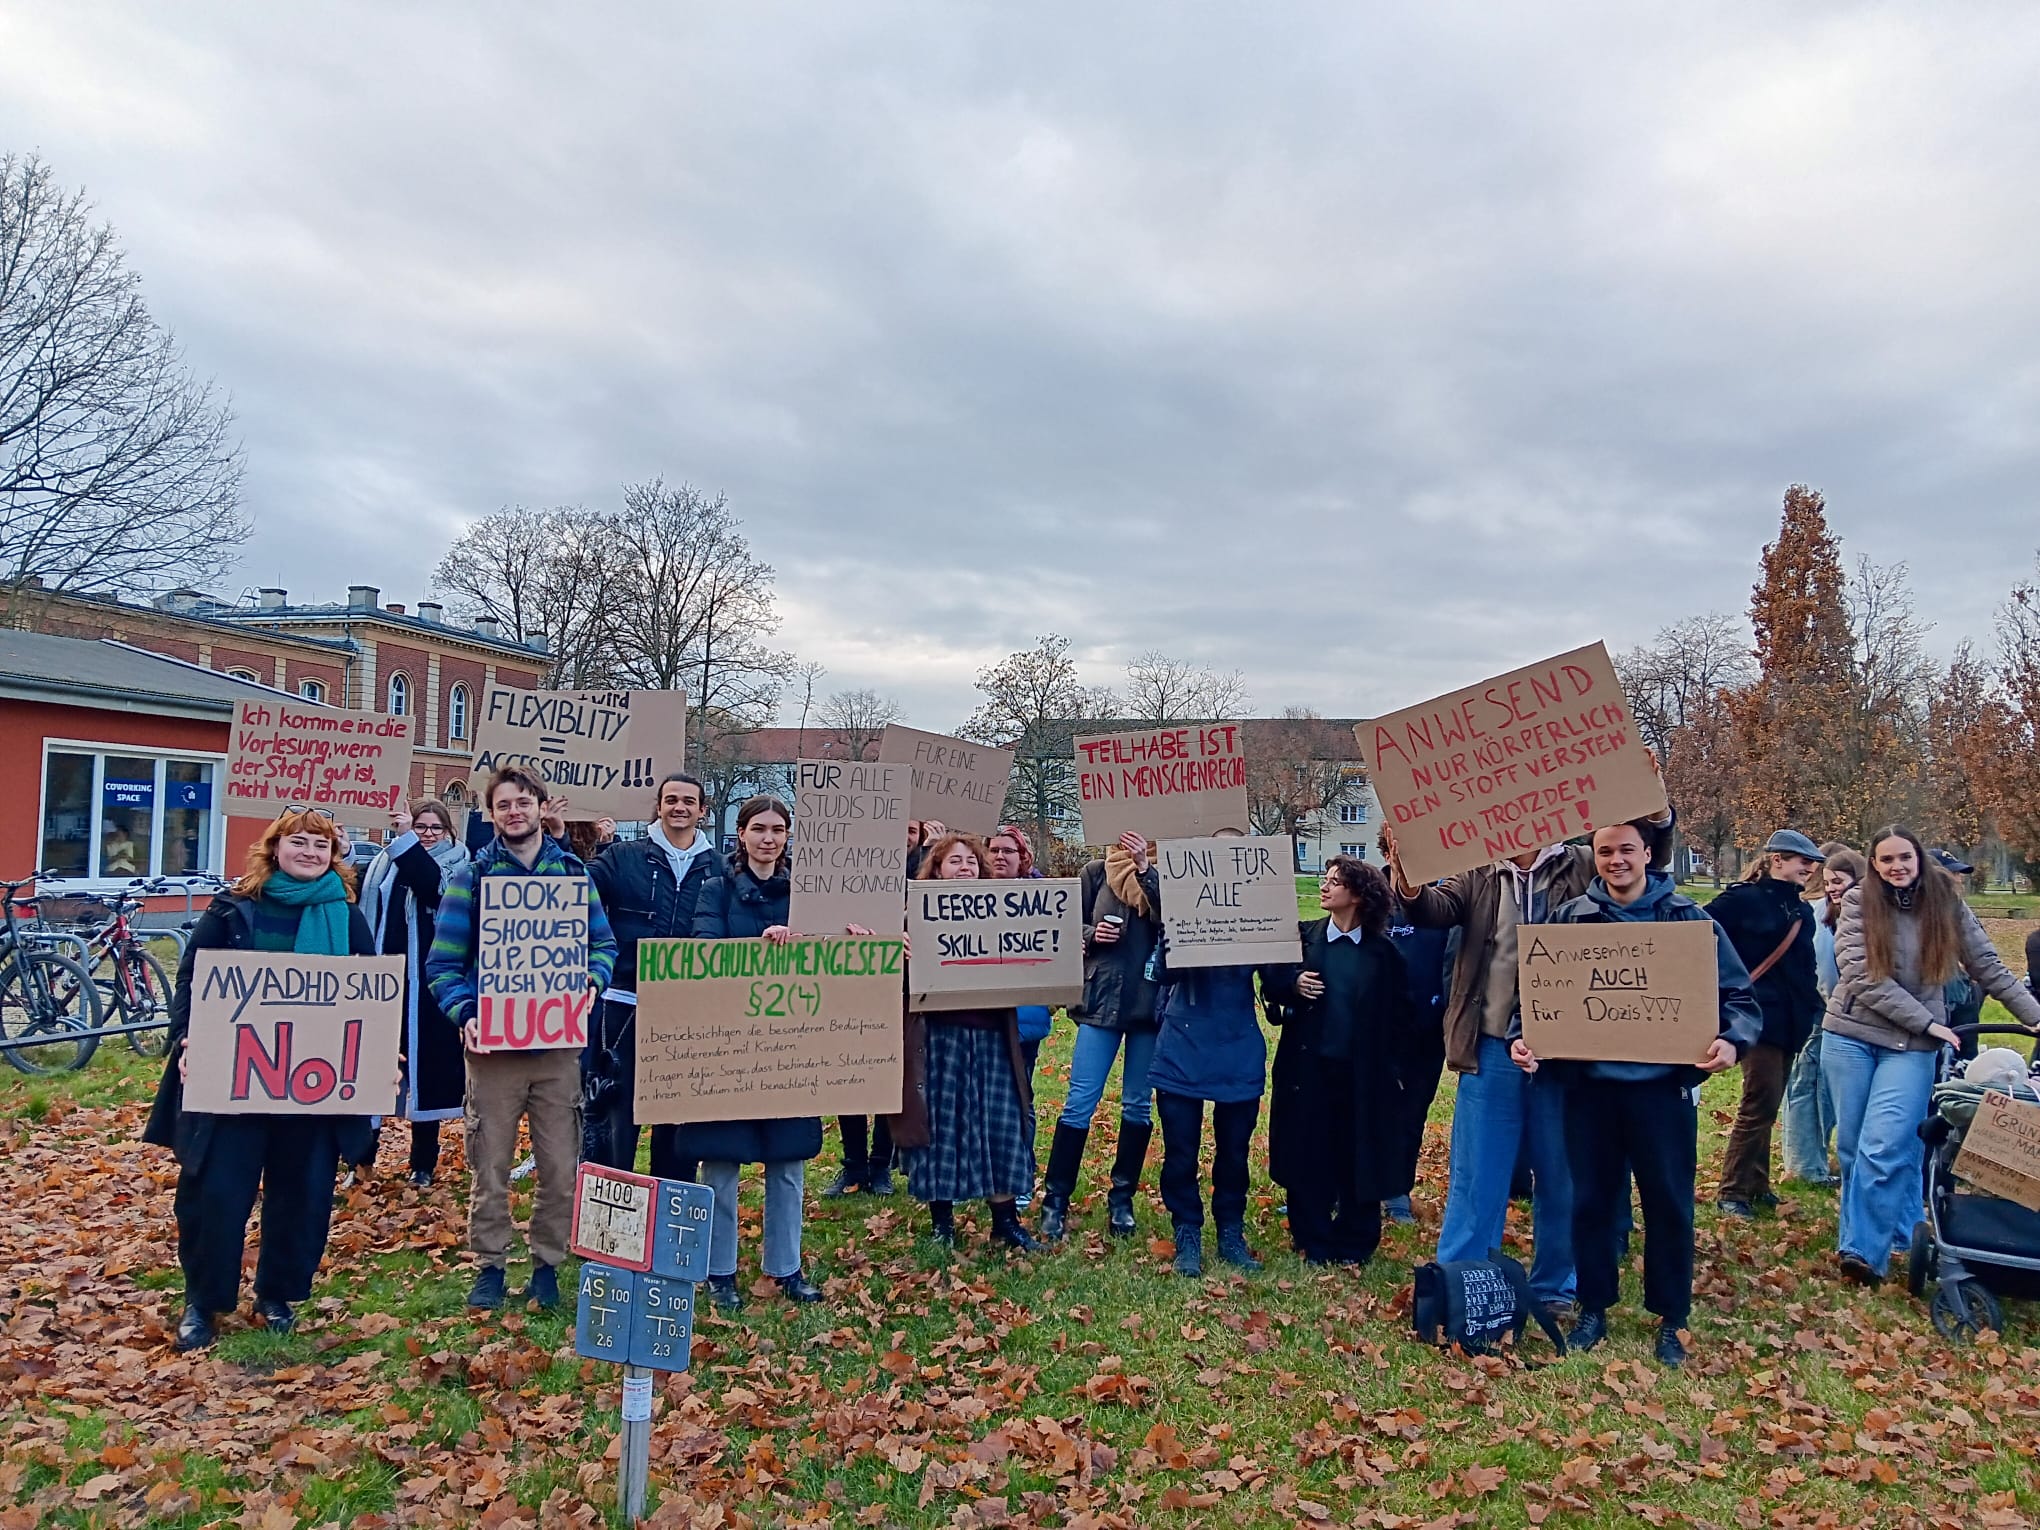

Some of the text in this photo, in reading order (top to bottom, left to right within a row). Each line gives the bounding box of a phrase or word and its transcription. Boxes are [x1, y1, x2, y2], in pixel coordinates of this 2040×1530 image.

[242, 703, 408, 738] Ich komme in die
[488, 690, 631, 742] FLEXIBLITY
[1374, 665, 1594, 772] ANWESEND
[914, 737, 979, 772] FÜR EINE
[1078, 726, 1237, 764] TEILHABE IST
[1411, 702, 1625, 790] NUR KÖRPERLICH
[231, 756, 264, 776] der
[263, 755, 323, 785] Stoff
[321, 763, 351, 788] gut
[800, 760, 894, 792] FÜR ALLE
[910, 769, 925, 790] NI
[927, 770, 958, 796] FÜR
[105, 783, 153, 793] COWORKING
[116, 793, 142, 802] SPACE
[227, 779, 270, 799] nicht
[275, 783, 311, 801] weil
[314, 785, 336, 803] ich
[1081, 772, 1115, 800] EIN
[1392, 790, 1442, 825] DEN
[1449, 764, 1518, 804] STOFF
[799, 793, 903, 820] STUDIS DIE
[1438, 773, 1598, 850] ICH TROTZDEM
[797, 820, 852, 843] NICHT
[795, 847, 901, 870] AM CAMPUS
[1229, 846, 1277, 876] FÜR
[794, 869, 905, 893] SEIN KÖNNEN
[485, 880, 588, 911] LOOK, I
[923, 889, 1068, 921] LEERER SAAL?
[481, 918, 587, 945] SHOWED
[481, 945, 526, 971] UP,
[937, 933, 989, 958] SKILL
[1526, 936, 1657, 966] Anwesenheit
[639, 940, 903, 981] HOCHSCHULRAHMENGESETZ
[479, 971, 588, 994] PUSH YOUR
[1531, 967, 1648, 989] dann AUCH
[202, 965, 401, 1023] MY ADHD SAID
[479, 992, 588, 1048] LUCK
[1532, 999, 1567, 1021] für
[747, 1023, 764, 1036] die
[769, 1021, 825, 1035] besonderen
[829, 1017, 888, 1036] Bedürfnisse
[640, 1054, 658, 1063] von
[665, 1045, 729, 1061] Studierenden
[733, 1041, 749, 1054] mit
[687, 1066, 714, 1085] dafür
[751, 1060, 773, 1073] dass
[777, 1055, 832, 1071] behinderte
[653, 1088, 680, 1100] ihrem
[691, 1082, 730, 1096] Studium
[734, 1081, 753, 1093] nicht
[761, 1075, 819, 1095] benachteiligt
[1985, 1092, 2010, 1110] ICH
[1996, 1113, 2040, 1144] GRUN
[594, 1177, 634, 1204] H100
[670, 1196, 708, 1221] S 100
[581, 1276, 630, 1304] AS 100
[648, 1287, 689, 1311] S 100
